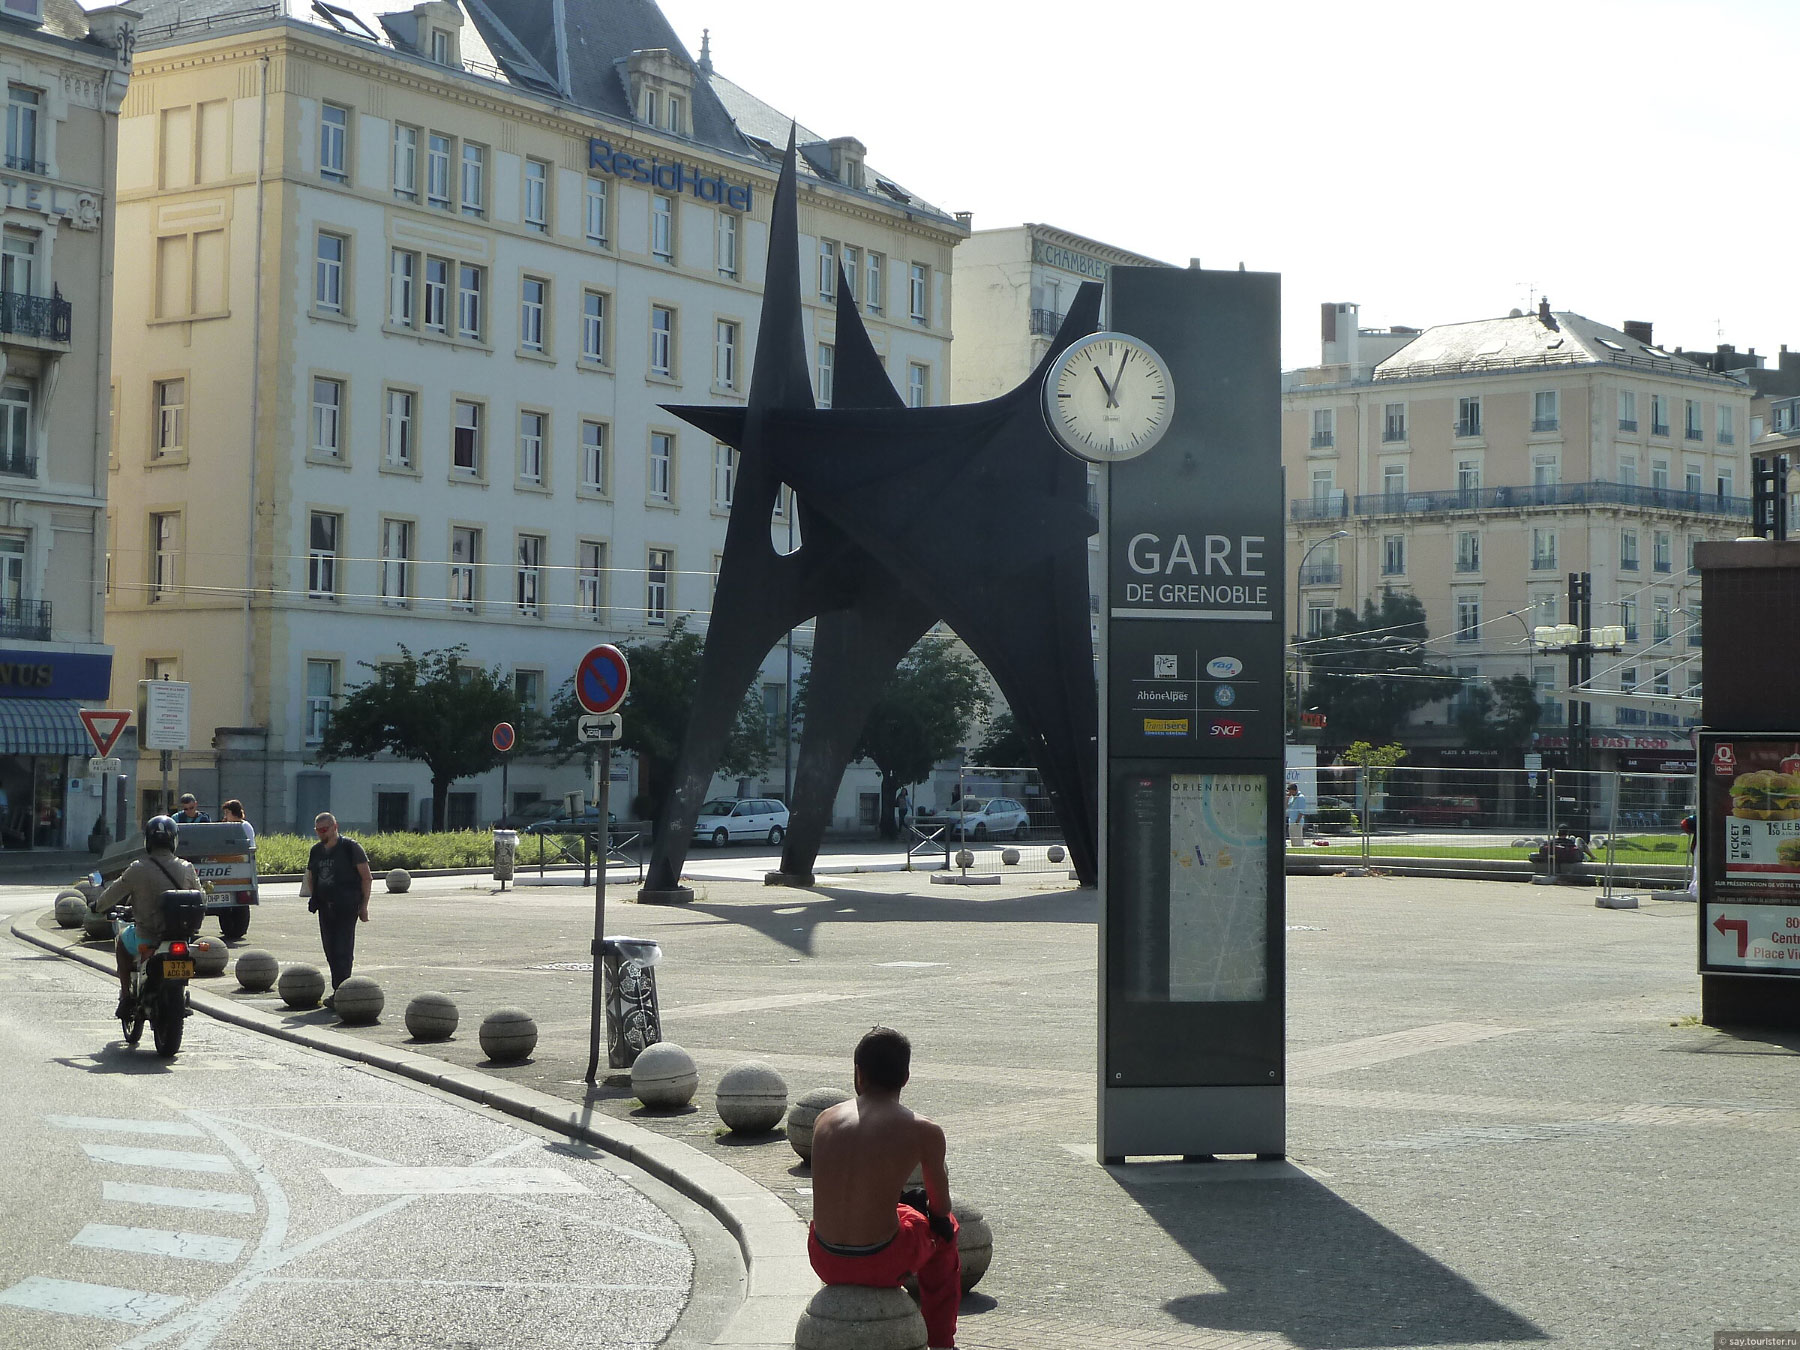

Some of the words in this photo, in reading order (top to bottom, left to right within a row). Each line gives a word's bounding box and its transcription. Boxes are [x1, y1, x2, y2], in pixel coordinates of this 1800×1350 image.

[588, 138, 753, 213] ResidHotel
[1127, 533, 1266, 577] GARE
[1126, 583, 1154, 602] DE
[1159, 584, 1268, 604] GRENOBLE
[1209, 725, 1242, 736] SNCF
[1603, 736, 1631, 748] FAST
[1635, 738, 1669, 749] FOOD
[1172, 782, 1262, 792] ORIENTATION
[1781, 822, 1792, 831] LE
[1730, 823, 1740, 860] TICKET
[1726, 880, 1767, 888] PRÉSENTATION
[1754, 947, 1785, 959] Place
